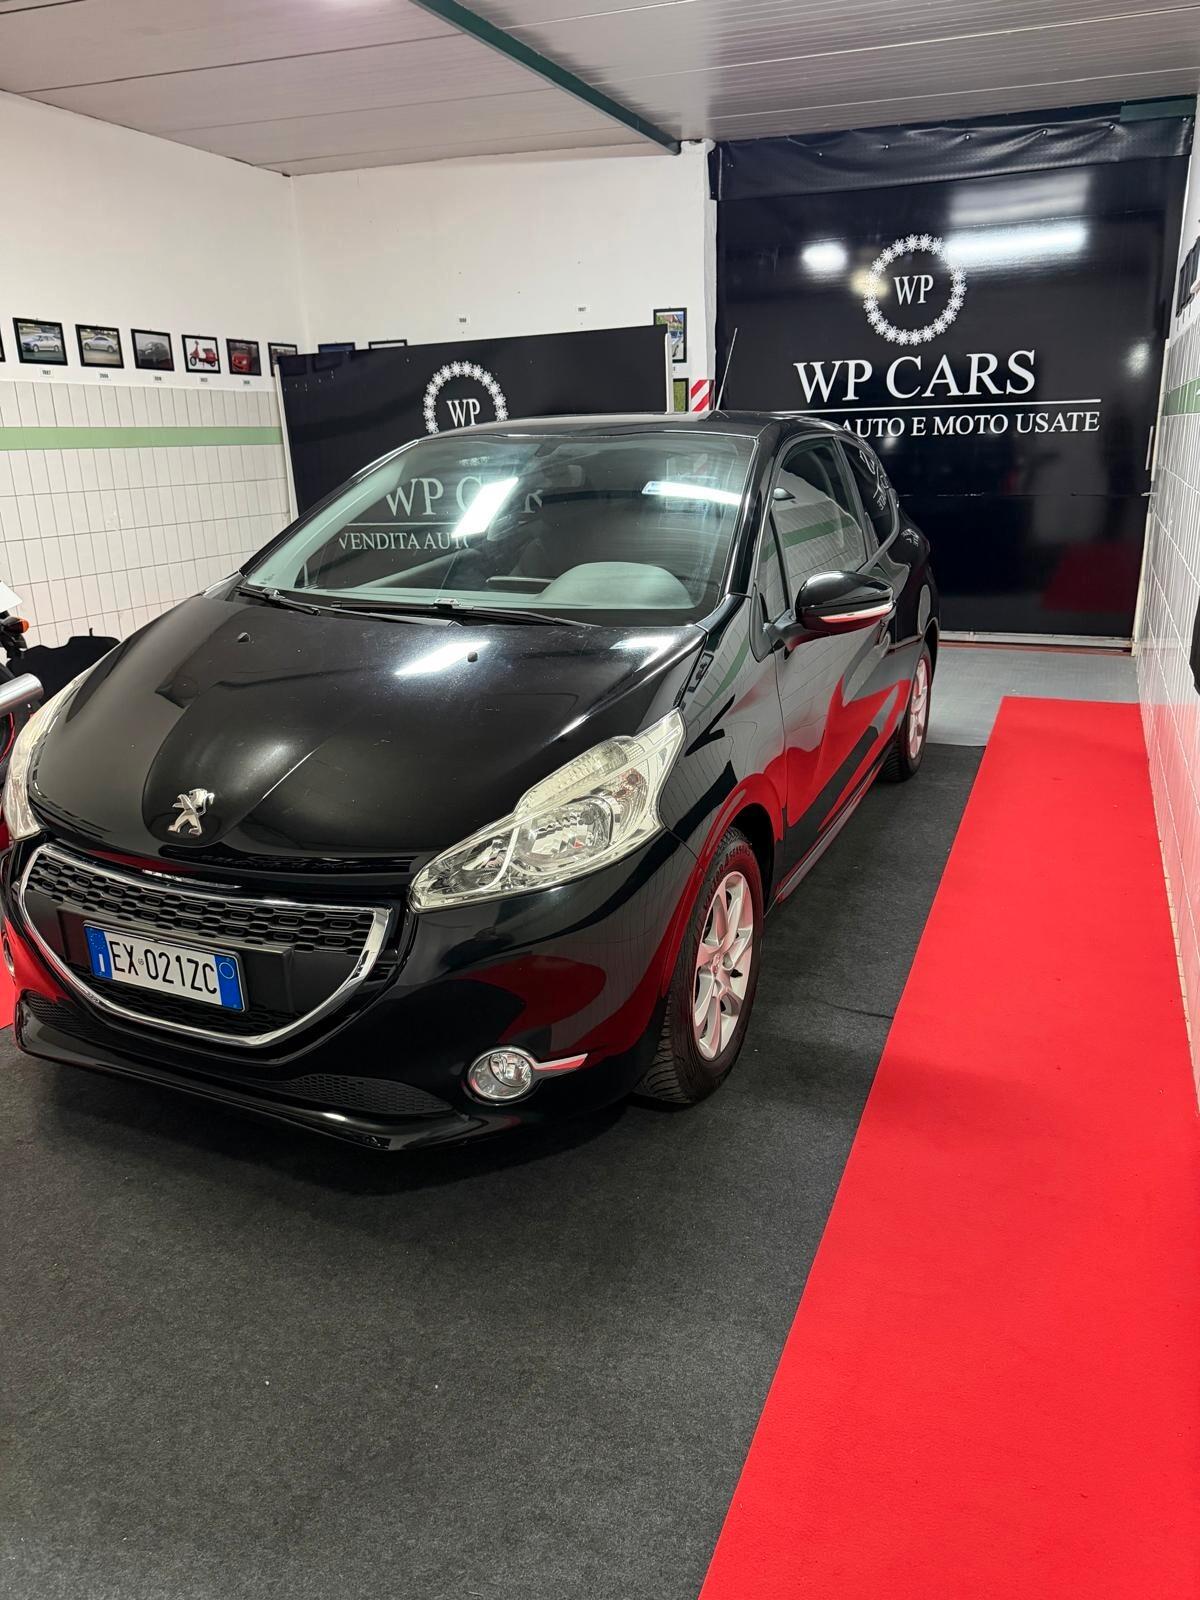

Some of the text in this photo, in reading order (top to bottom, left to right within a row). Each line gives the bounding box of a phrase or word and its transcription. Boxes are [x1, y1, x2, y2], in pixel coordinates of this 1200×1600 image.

[893, 274, 934, 306] WP
[793, 349, 1036, 403] WP CARS
[446, 398, 481, 427] WP
[843, 411, 1100, 438] AUTO E MOTO USATE
[385, 477, 444, 517] WP
[338, 532, 421, 550] VENDITA
[108, 940, 218, 995] EX 021ZC
